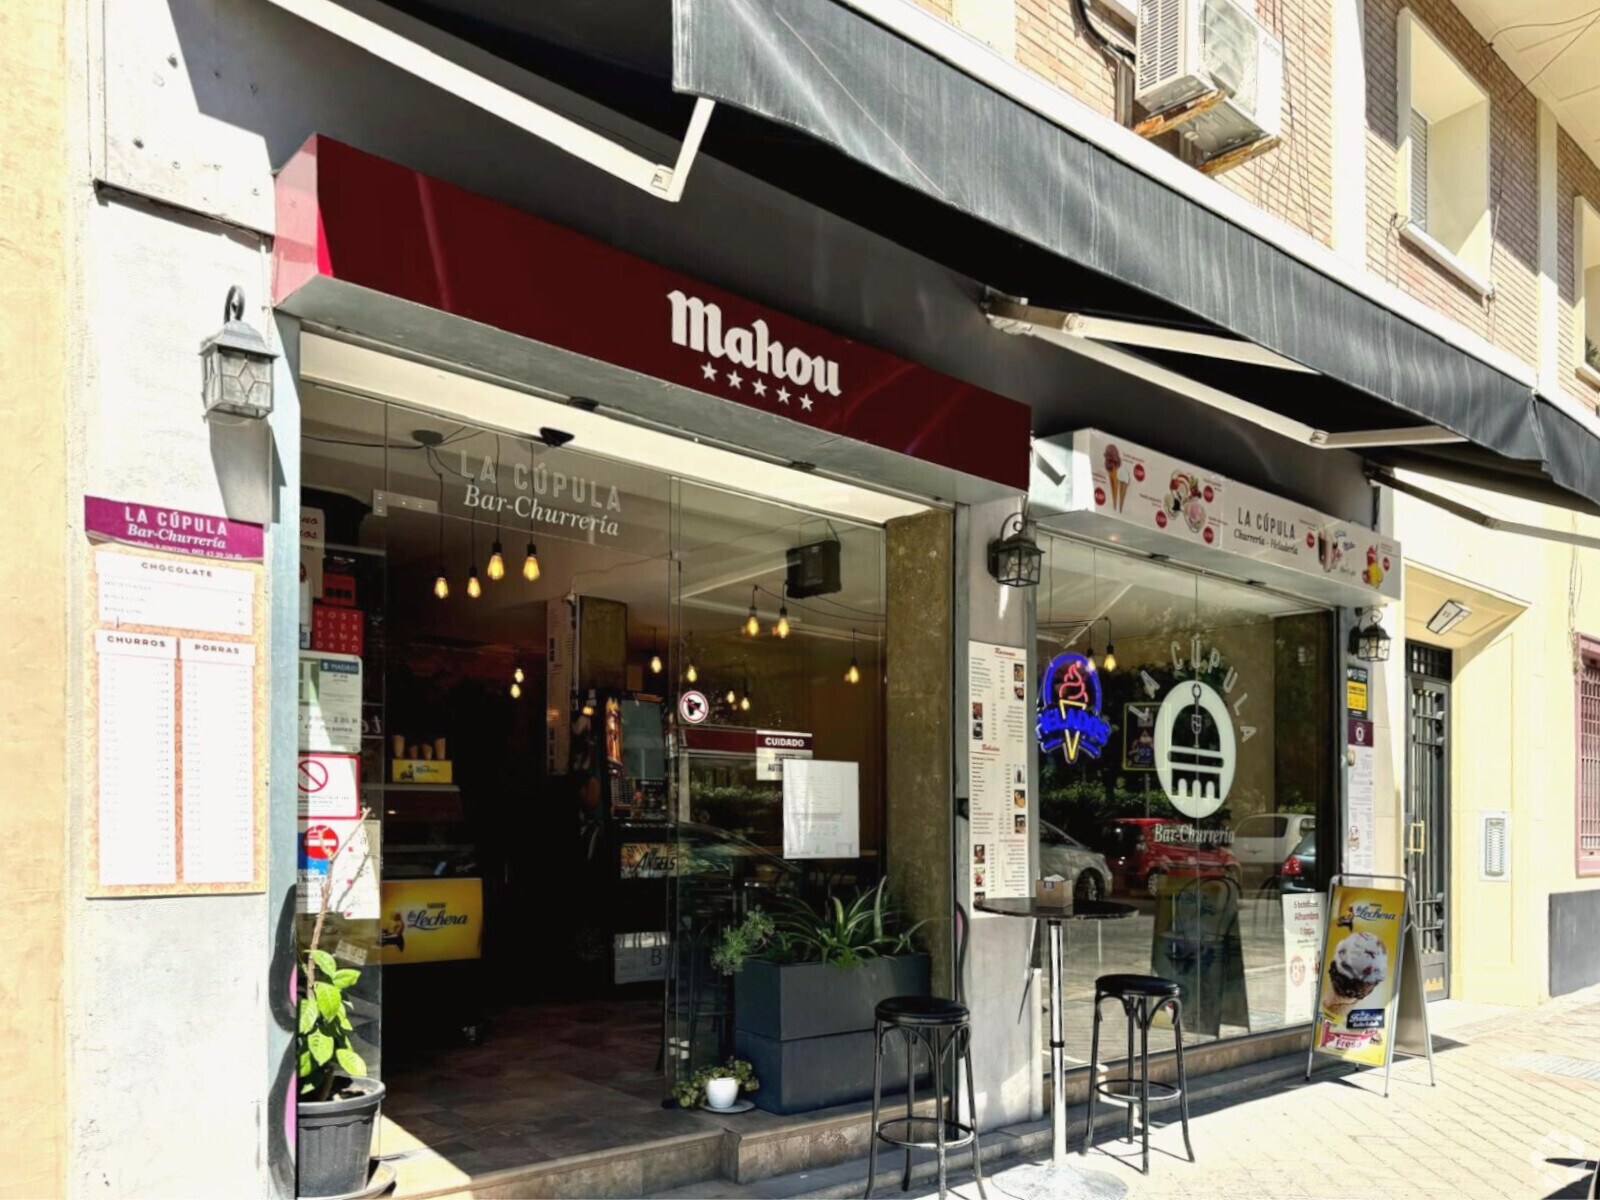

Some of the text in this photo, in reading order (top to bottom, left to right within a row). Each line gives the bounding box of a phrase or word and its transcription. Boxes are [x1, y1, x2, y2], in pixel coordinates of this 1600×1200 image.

[667, 289, 842, 397] Mahou
[461, 450, 622, 513] LA CÚPULA
[125, 506, 228, 536] LA CÚPULA
[463, 484, 619, 537] Bar-Churrería
[1238, 507, 1252, 526] LA
[1256, 512, 1296, 540] CÚPULA
[127, 523, 227, 549] Bar-Churrería
[141, 561, 213, 577] CHOCOLATE
[107, 634, 167, 649] CHURROS
[194, 643, 241, 656] PORRAS
[1036, 707, 1111, 746] HELADOS
[764, 737, 805, 747] CUIDADO
[1153, 822, 1235, 844] Bar-Churrería
